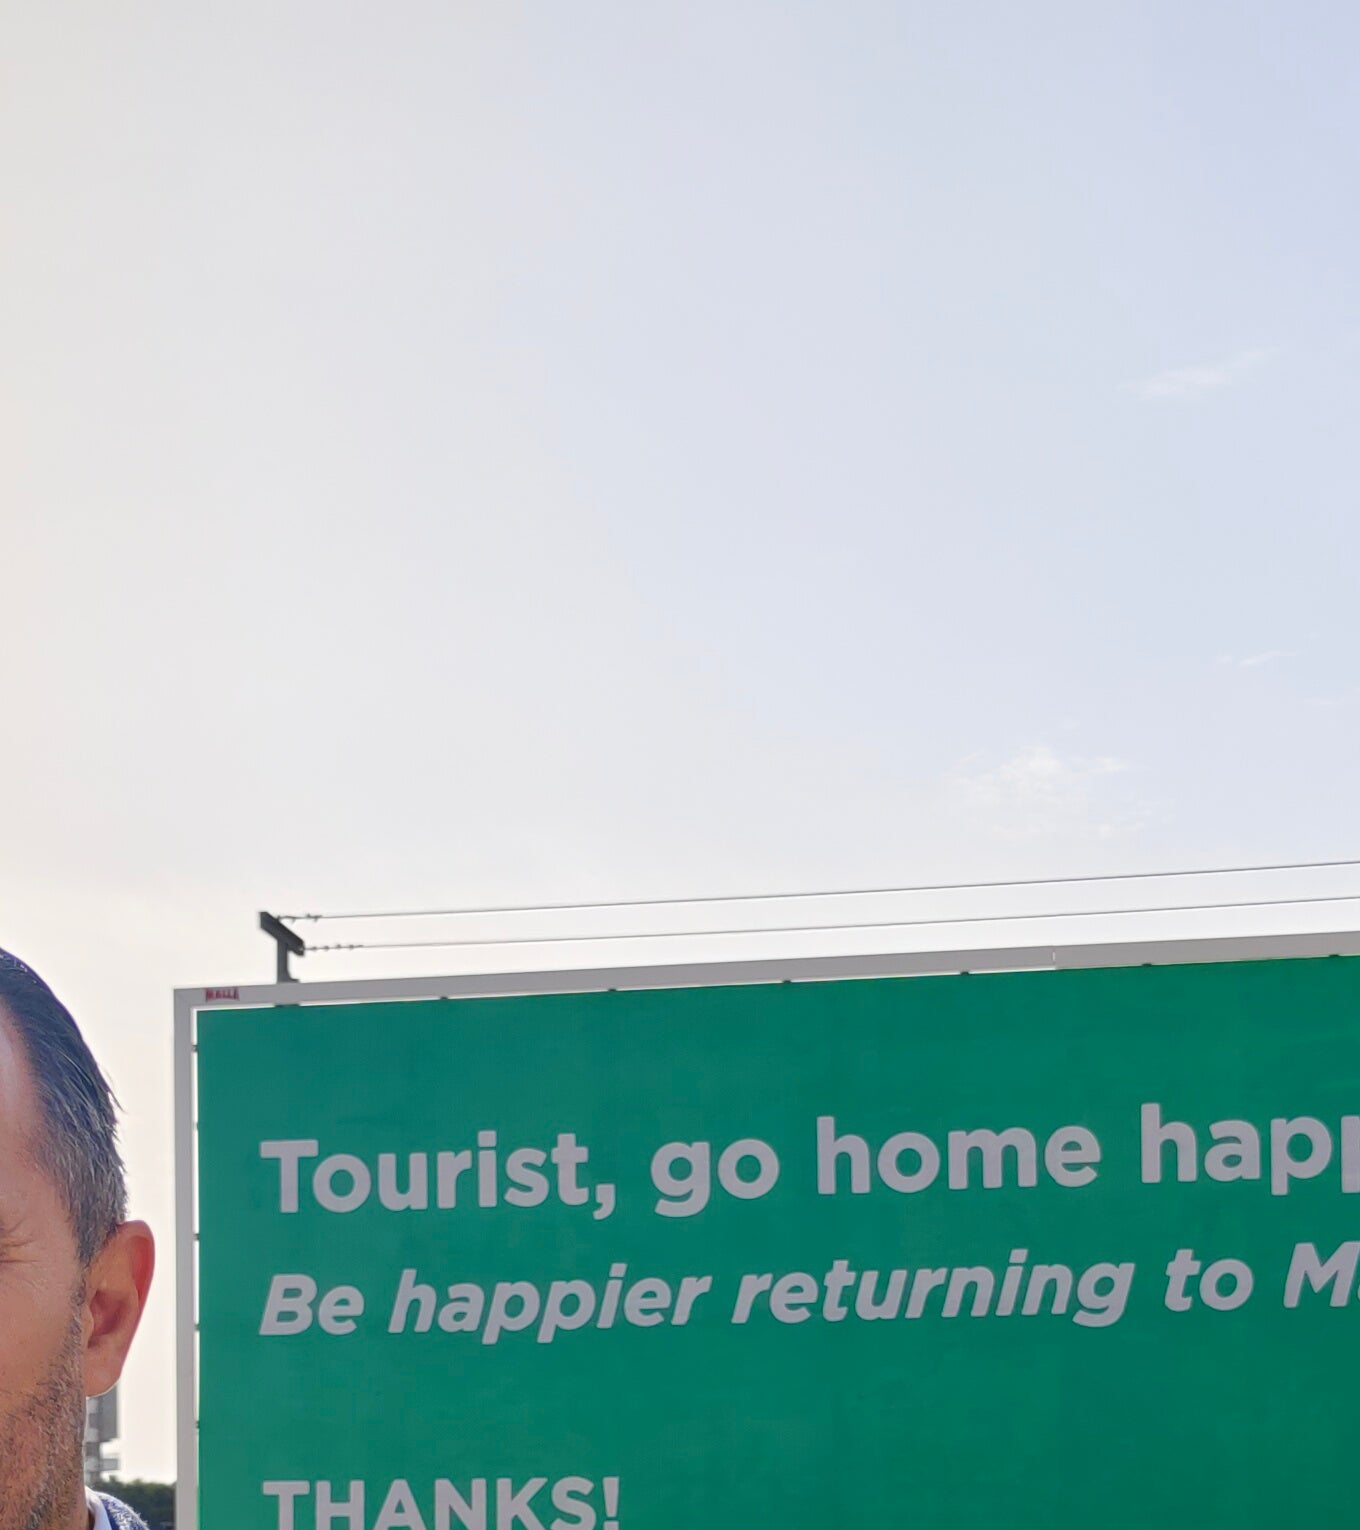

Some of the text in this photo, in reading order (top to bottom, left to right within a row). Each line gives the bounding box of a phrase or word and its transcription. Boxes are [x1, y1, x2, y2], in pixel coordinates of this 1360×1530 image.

[260, 1131, 615, 1219] Tourist,
[651, 1139, 779, 1217] go
[818, 1116, 1100, 1194] home
[260, 1274, 364, 1335] Be
[389, 1263, 712, 1344] happier
[732, 1249, 1134, 1326] returning
[1165, 1249, 1253, 1311] to
